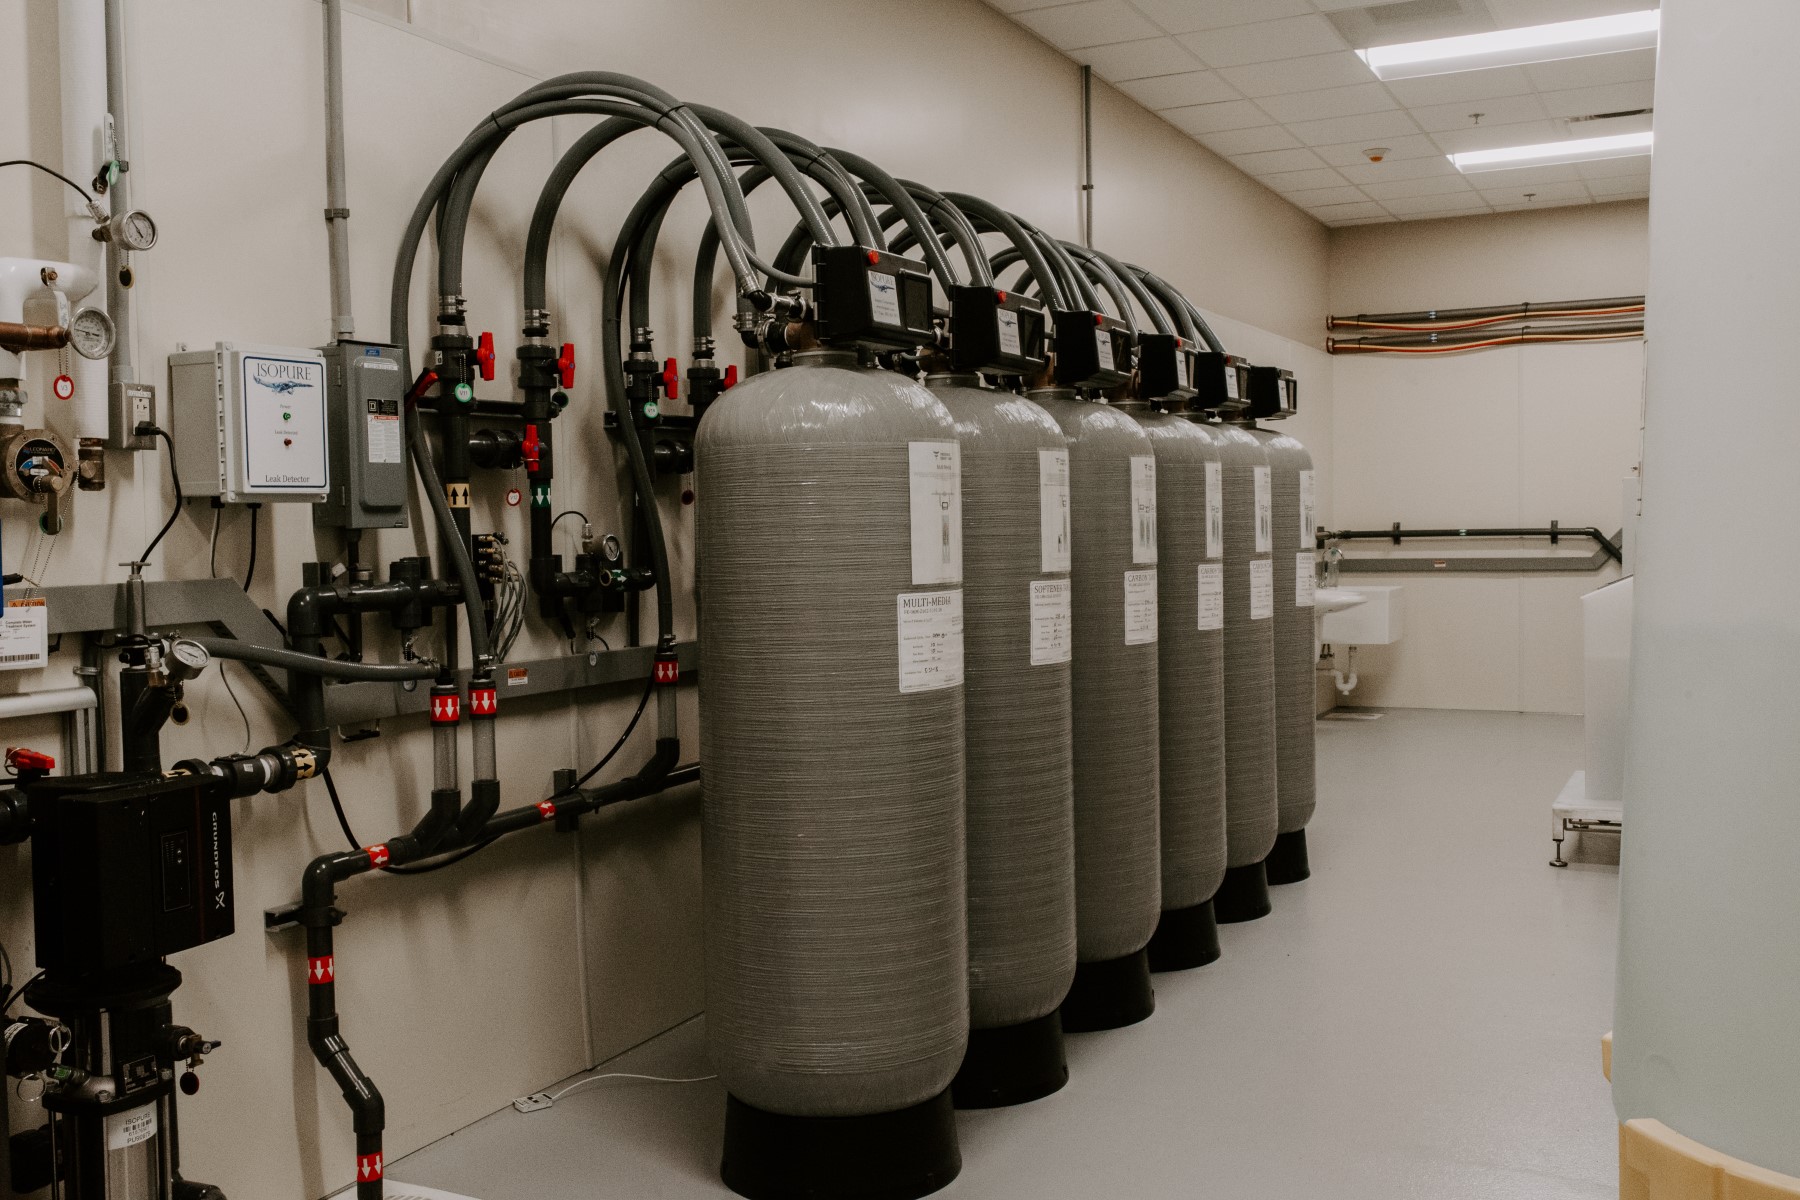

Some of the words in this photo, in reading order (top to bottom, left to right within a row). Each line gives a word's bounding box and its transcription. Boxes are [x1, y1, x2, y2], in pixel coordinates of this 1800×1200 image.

[255, 363, 312, 381] ISOPURE
[265, 474, 281, 483] Leak
[282, 475, 310, 483] Detector
[1034, 584, 1063, 594] SOFTENER
[903, 596, 952, 608] MULTI-MEDIA
[212, 811, 220, 889] GRUNDFOS
[125, 1112, 151, 1125] ISOPURE
